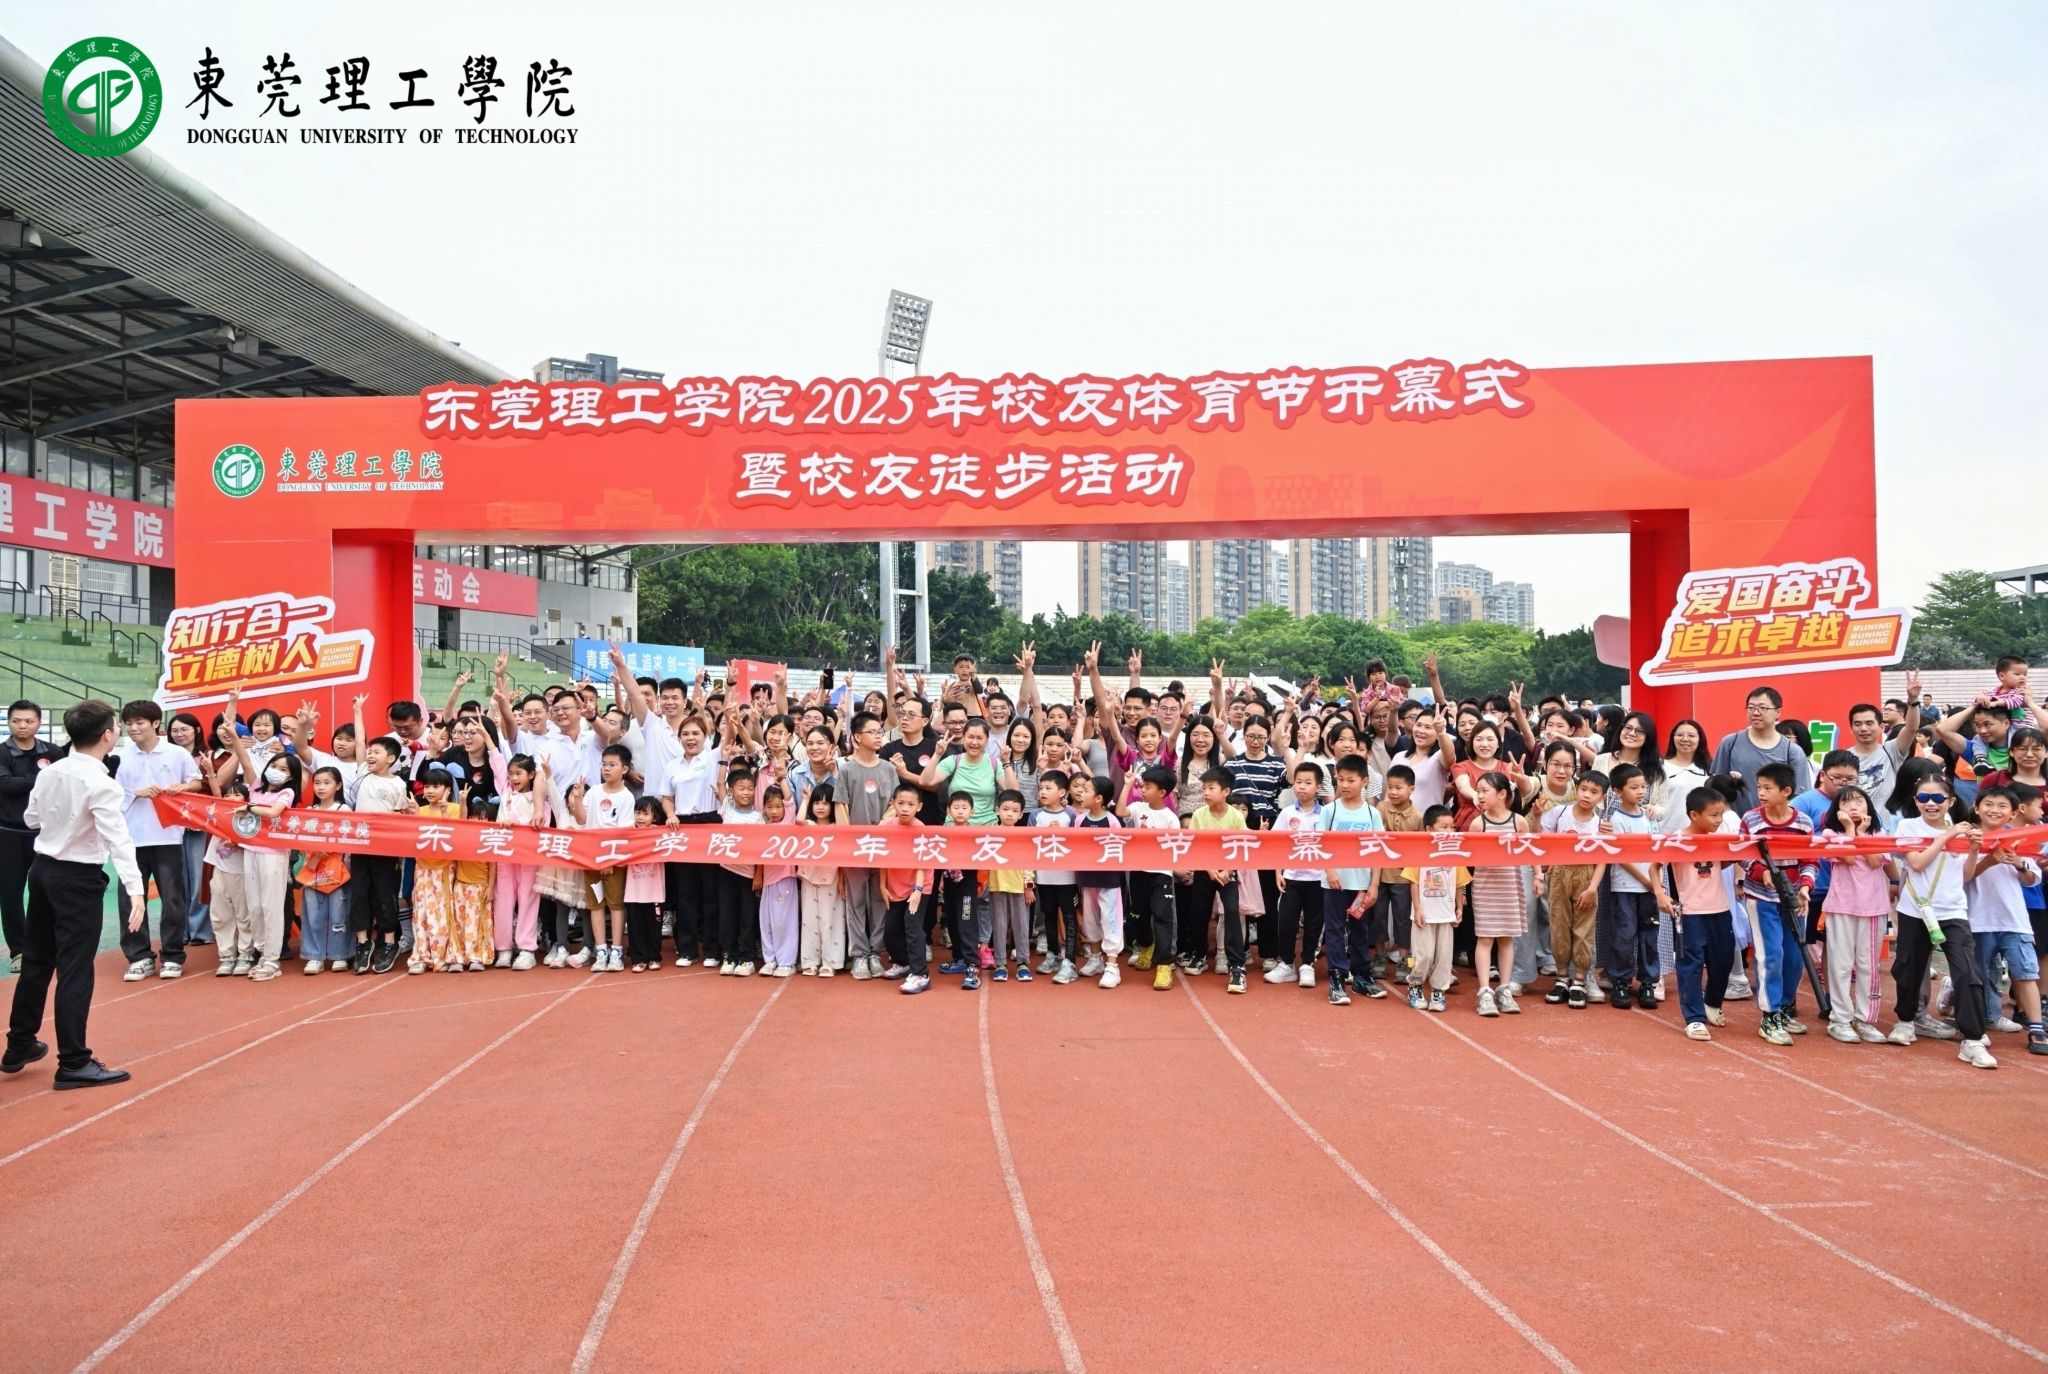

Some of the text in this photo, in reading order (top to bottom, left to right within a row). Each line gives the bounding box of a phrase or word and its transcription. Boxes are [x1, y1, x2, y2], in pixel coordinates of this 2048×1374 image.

[425, 364, 1527, 432] 东莞理工学院2025年校友体育节开幕式
[277, 449, 443, 480] 東莞理工學院
[736, 450, 1185, 500] 暨校友徒步活动
[1681, 566, 1861, 616] 爱国奋斗
[170, 600, 321, 651] 知行合一
[1667, 612, 1845, 660] 追求卓越
[165, 634, 315, 689] 立德树人
[586, 649, 638, 670] 青春感
